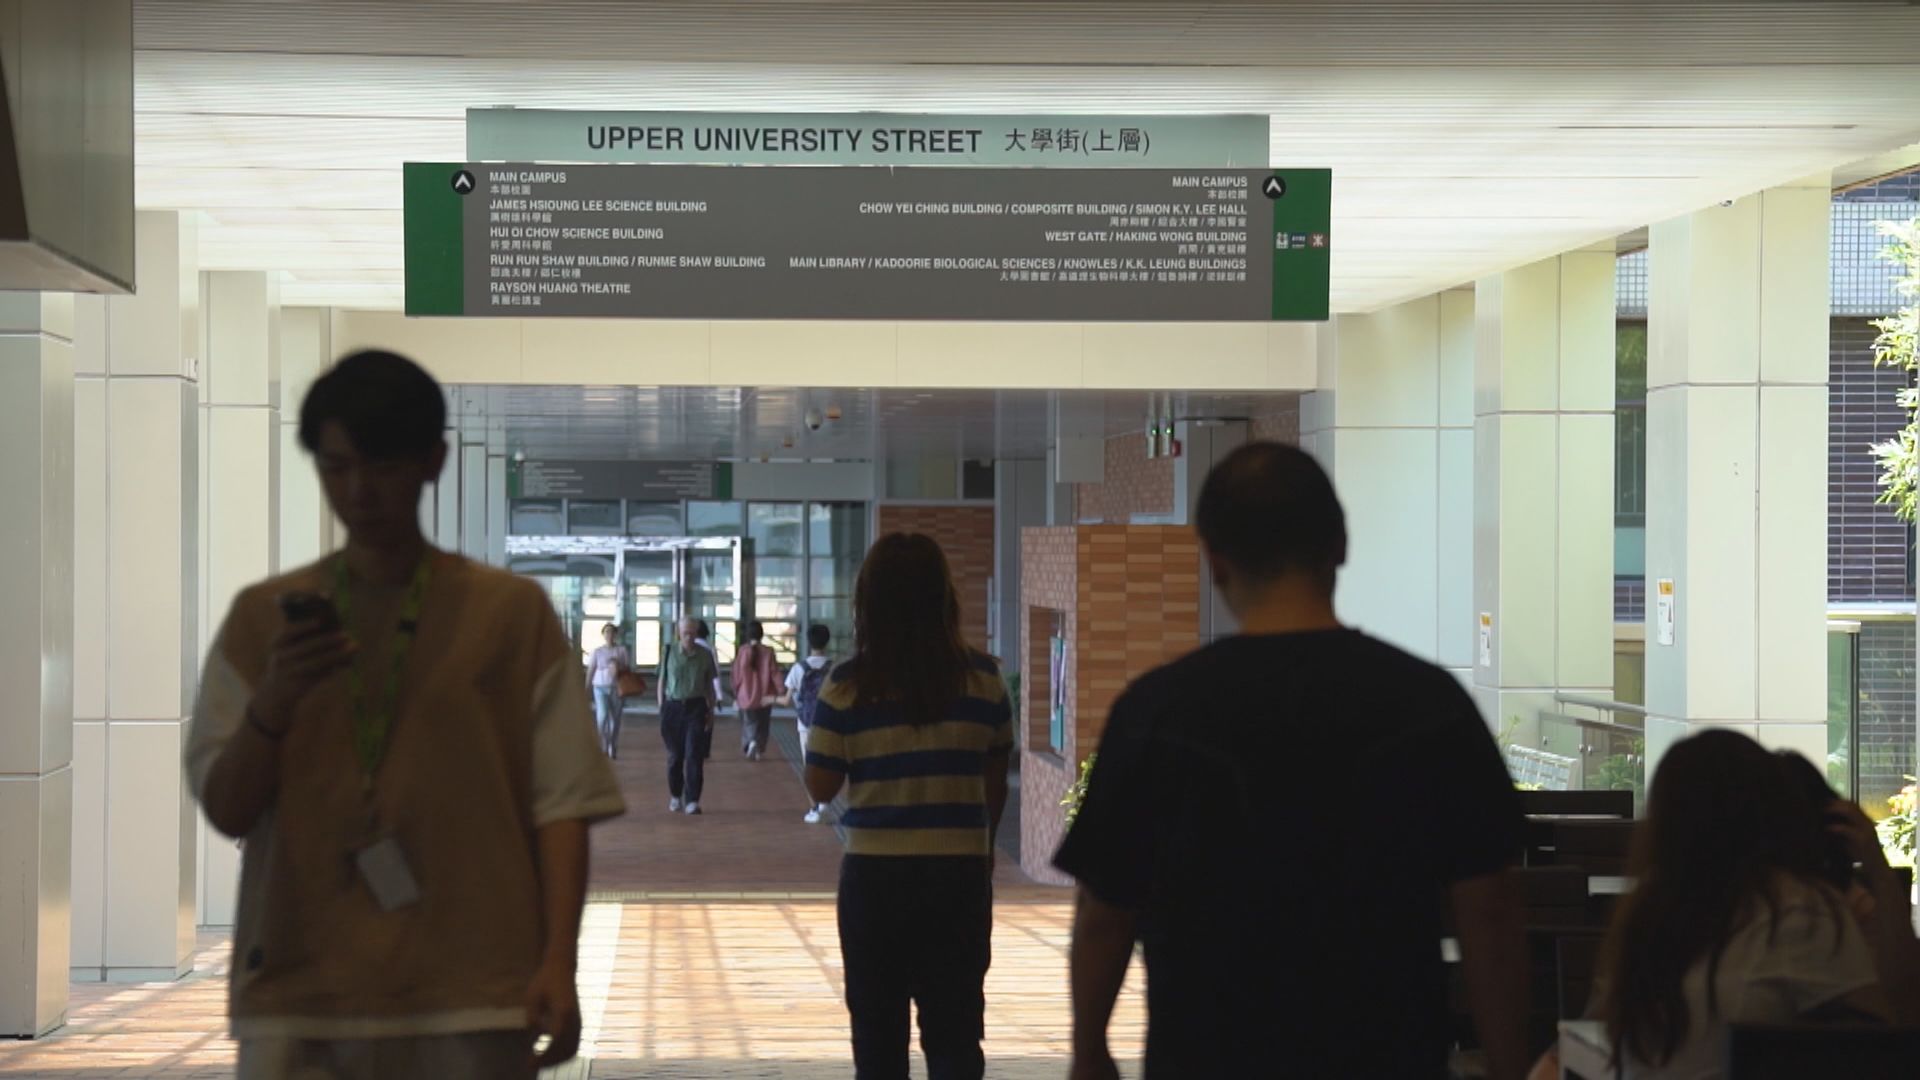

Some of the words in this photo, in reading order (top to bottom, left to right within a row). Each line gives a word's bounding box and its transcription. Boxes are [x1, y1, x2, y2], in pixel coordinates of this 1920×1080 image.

[588, 126, 683, 149] UPPER
[694, 128, 862, 151] UNIVERSITY
[872, 129, 982, 153] STREET
[1005, 127, 1150, 156] 大學街(上層)
[489, 172, 518, 183] MAIN
[520, 172, 567, 184] CAMPUS
[1172, 177, 1199, 187] MAIN
[1202, 177, 1248, 188] CAMPUS
[489, 200, 527, 211] JAMES
[529, 200, 580, 211] HSIOUNG
[582, 200, 604, 212] LEE
[605, 201, 654, 212] SCIENCE
[656, 202, 708, 212] BUILDING
[859, 203, 894, 214] CHOW
[895, 204, 913, 214] YEI
[915, 204, 950, 214] CHING
[952, 204, 1003, 214] BUILDING
[1011, 204, 1075, 215] COMPOSITE
[1077, 204, 1128, 215] BUILDING
[1136, 204, 1171, 215] SIMON
[1173, 205, 1194, 215] K.Y.
[1196, 204, 1217, 215] LEE
[1219, 205, 1248, 215] HALL
[490, 227, 509, 238] HUI
[511, 228, 524, 238] OI
[525, 228, 560, 238] CHOW
[562, 228, 610, 240] SCIENCE
[612, 228, 664, 240] BUILDING
[1044, 232, 1077, 242] WEST
[1079, 232, 1107, 242] GATE
[1115, 232, 1158, 242] HAKING
[1160, 232, 1194, 242] WONG
[1196, 232, 1247, 242] BUILDING
[490, 255, 514, 265] RUN
[516, 255, 540, 265] RUN
[542, 256, 575, 266] SHAW
[577, 256, 630, 267] BUILDING
[638, 256, 677, 267] RUNME
[680, 257, 712, 267] SHAW
[714, 257, 766, 268] BUILDING
[789, 258, 817, 268] MAIN
[819, 258, 867, 268] LIBRARY
[874, 258, 932, 269] KADOORIE
[934, 258, 1000, 269] BIOLOGICAL
[1002, 259, 1056, 269] SCIENCES
[1064, 259, 1118, 269] KNOWLES
[1125, 260, 1148, 269] K.K.
[1150, 260, 1187, 270] LEUNG
[1189, 259, 1247, 270] BUILDINGS
[490, 283, 536, 293] RAYSON
[538, 283, 578, 294] HUANG
[580, 283, 631, 294] THEATRE
